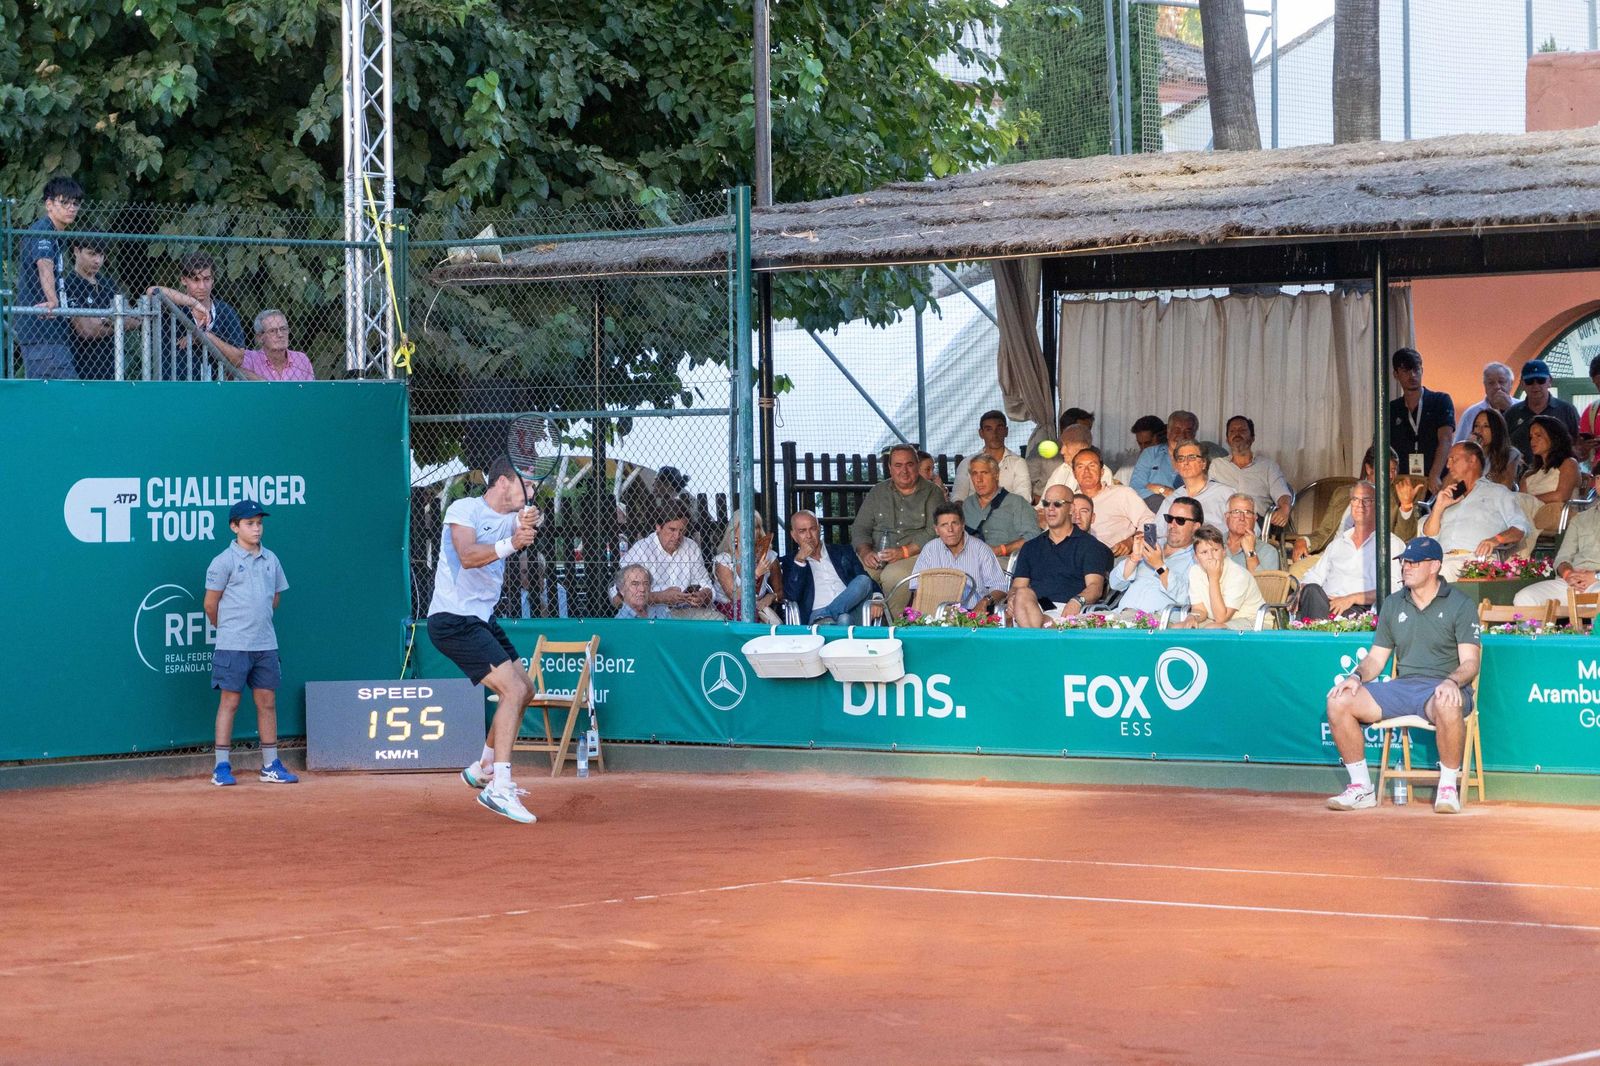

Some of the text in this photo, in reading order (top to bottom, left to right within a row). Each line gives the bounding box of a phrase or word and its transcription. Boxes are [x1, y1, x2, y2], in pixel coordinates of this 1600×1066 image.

[113, 493, 138, 504] ATP
[146, 475, 307, 507] CHALLENGER
[147, 510, 215, 542] TOUR
[165, 612, 217, 647] RFE
[165, 651, 215, 663] REAL FEDER
[165, 662, 213, 674] ESPAÑOLA D
[357, 686, 434, 700] SPEED
[1063, 674, 1152, 719] FOX
[368, 706, 446, 742] 155
[1120, 721, 1153, 737] ESS
[375, 748, 419, 760] KM/H
